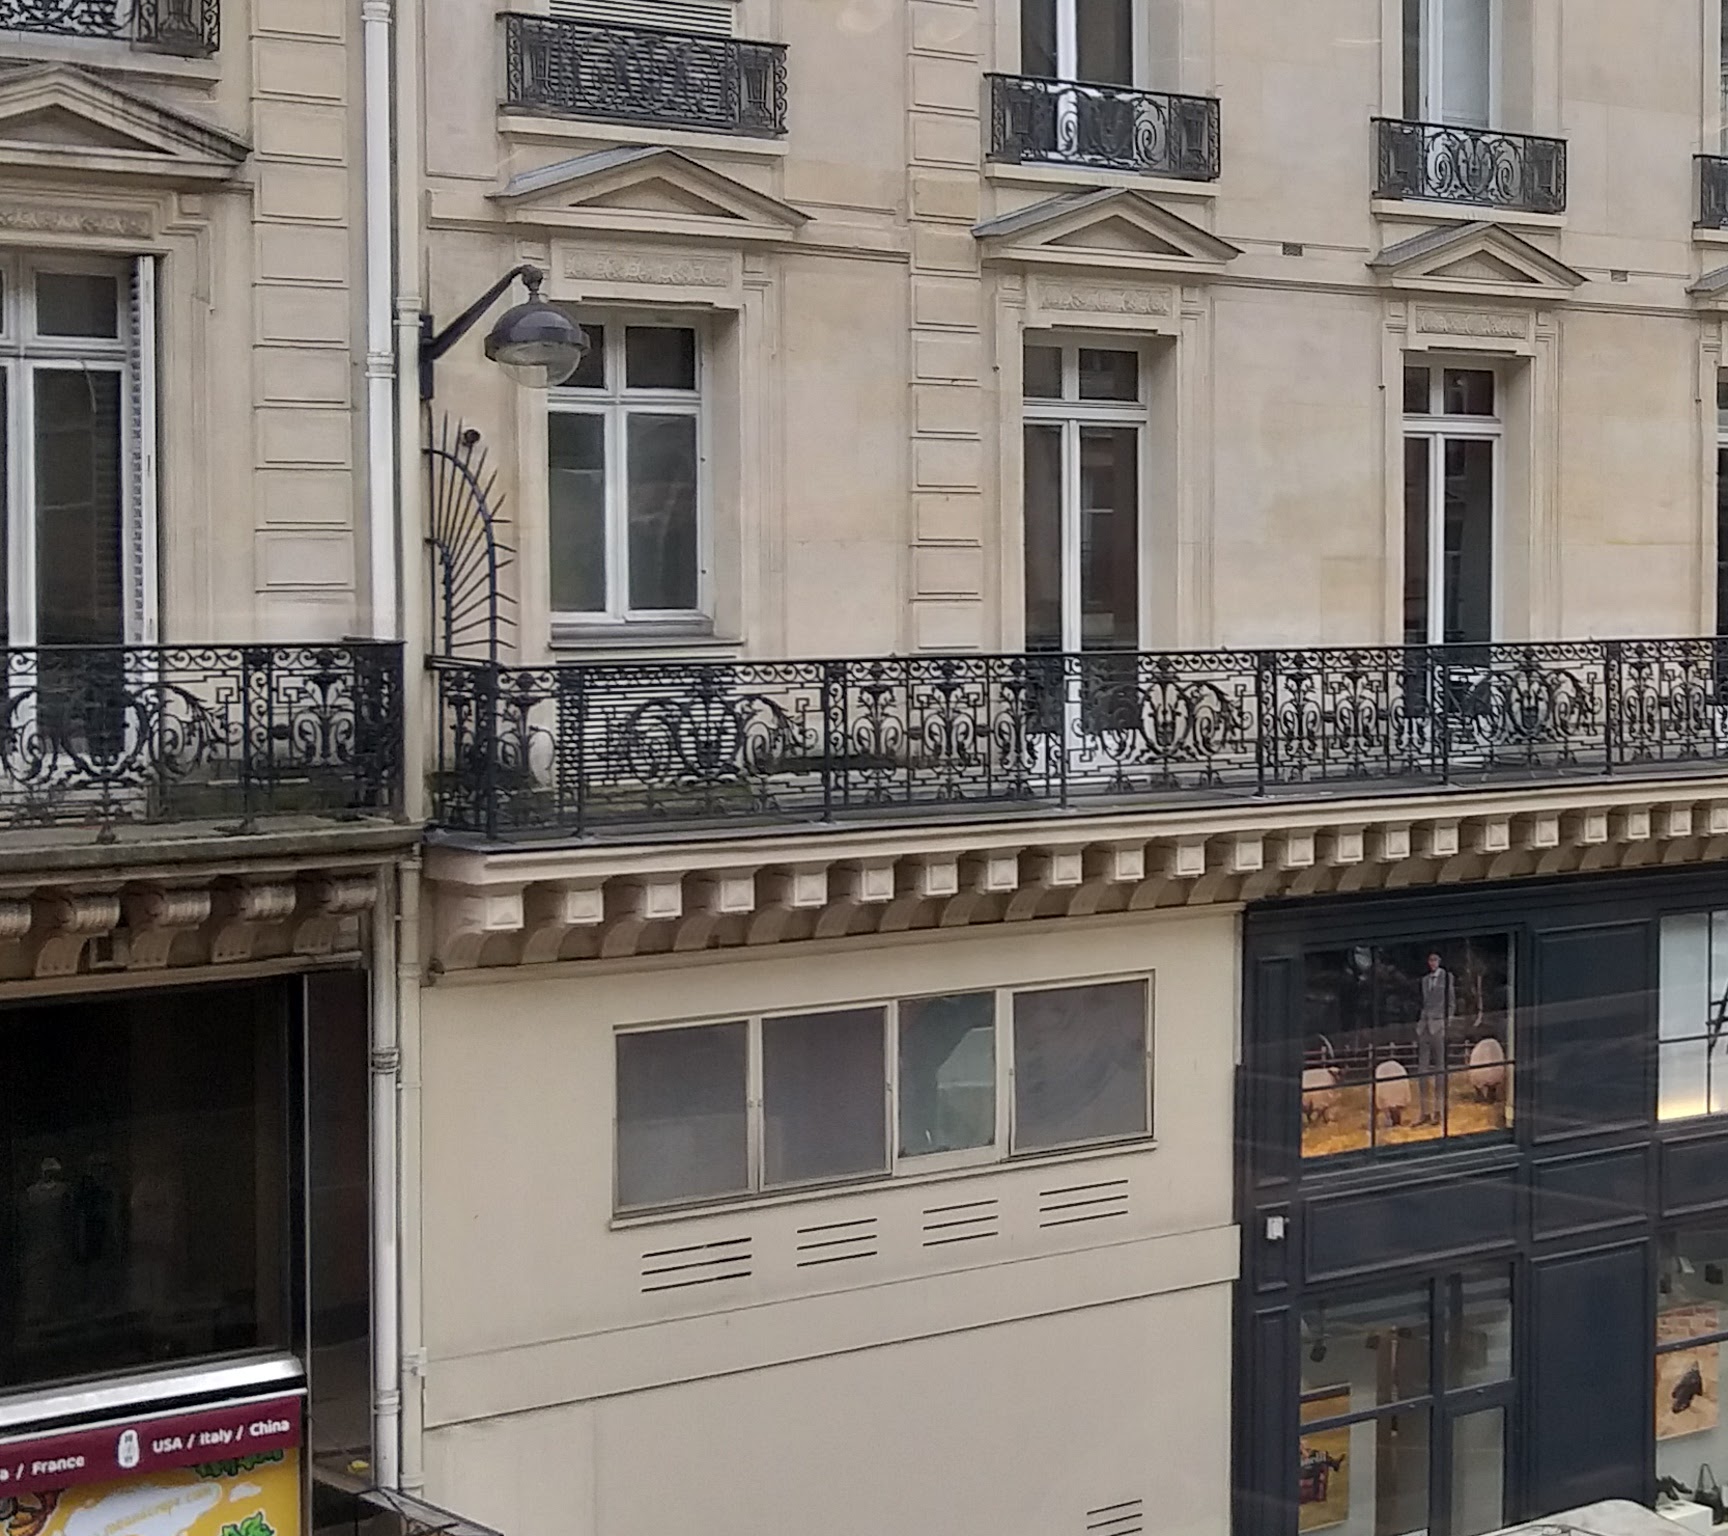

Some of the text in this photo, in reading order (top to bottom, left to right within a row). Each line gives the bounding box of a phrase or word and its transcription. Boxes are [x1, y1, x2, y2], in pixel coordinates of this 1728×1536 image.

[152, 1438, 183, 1453] USA
[200, 1427, 232, 1447] Italy
[249, 1419, 290, 1437] China
[31, 1454, 85, 1476] France
